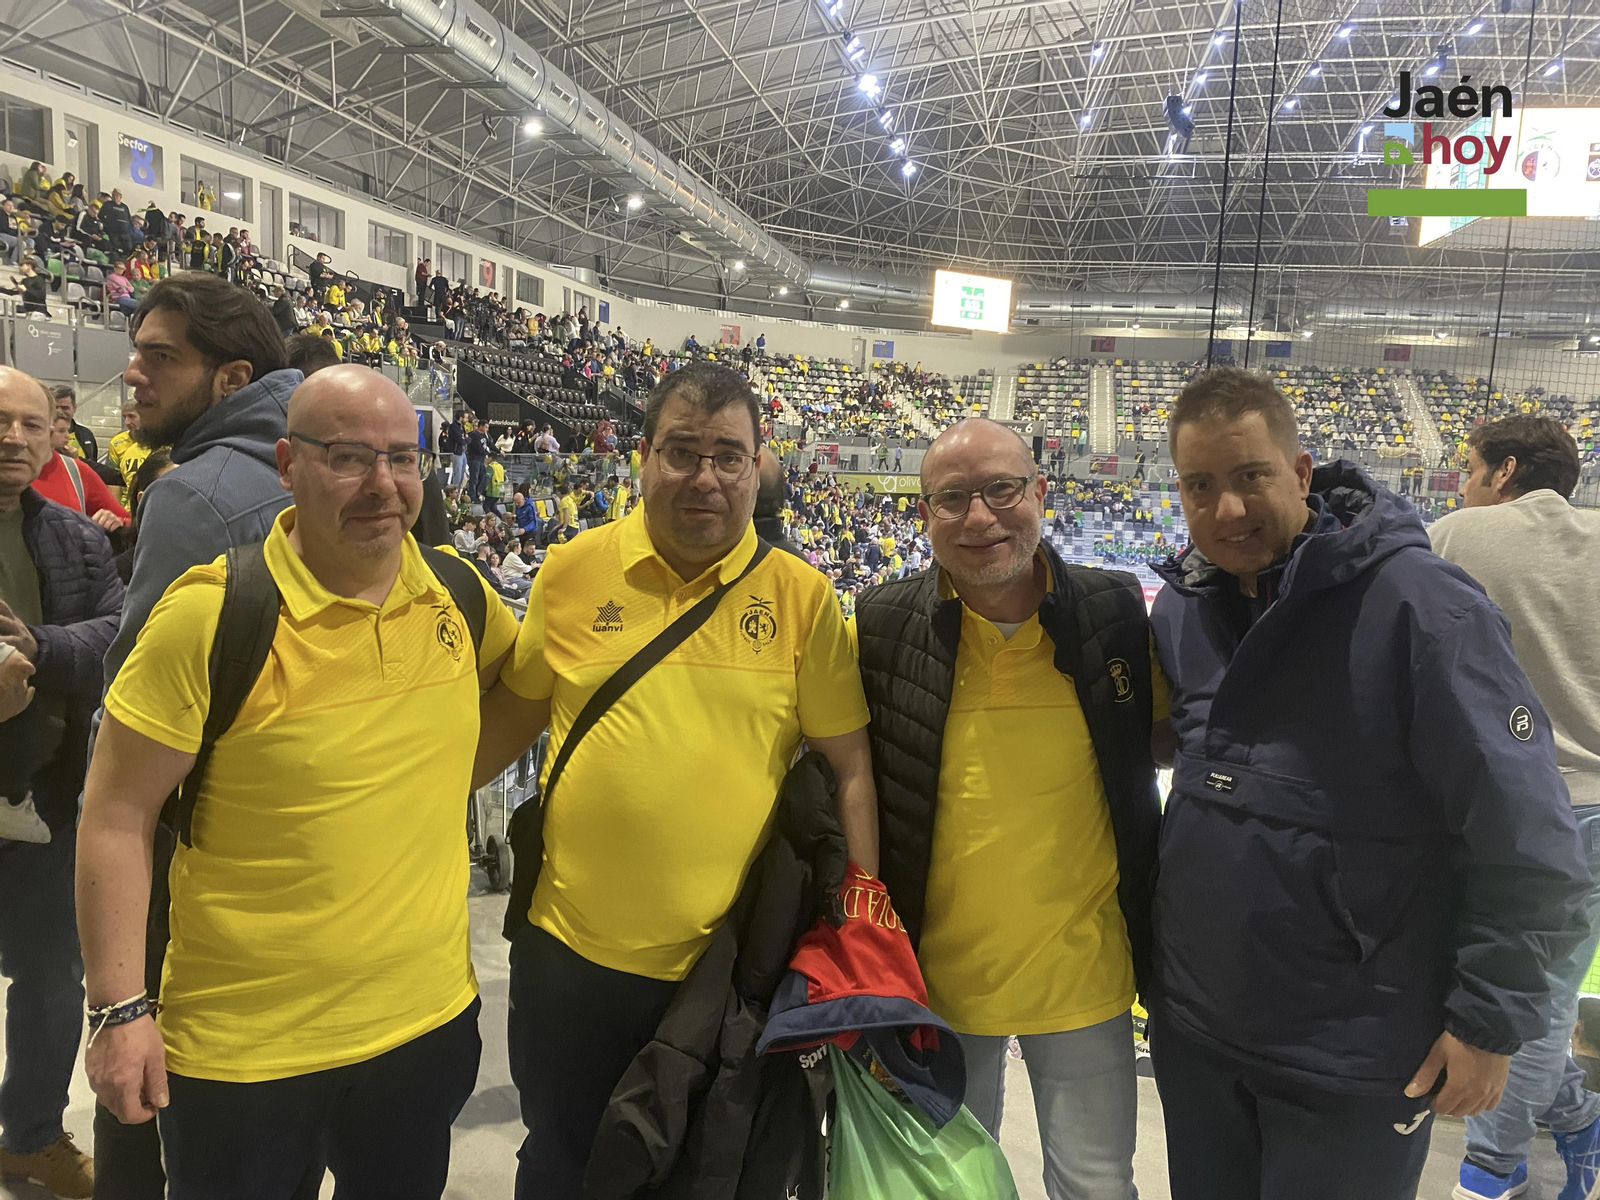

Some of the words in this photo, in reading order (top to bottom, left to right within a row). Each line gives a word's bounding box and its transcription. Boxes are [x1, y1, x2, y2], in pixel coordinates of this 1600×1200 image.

[118, 133, 148, 153] Sector
[130, 138, 155, 187] 8
[1025, 422, 1034, 434] 6
[592, 624, 624, 632] luanvi
